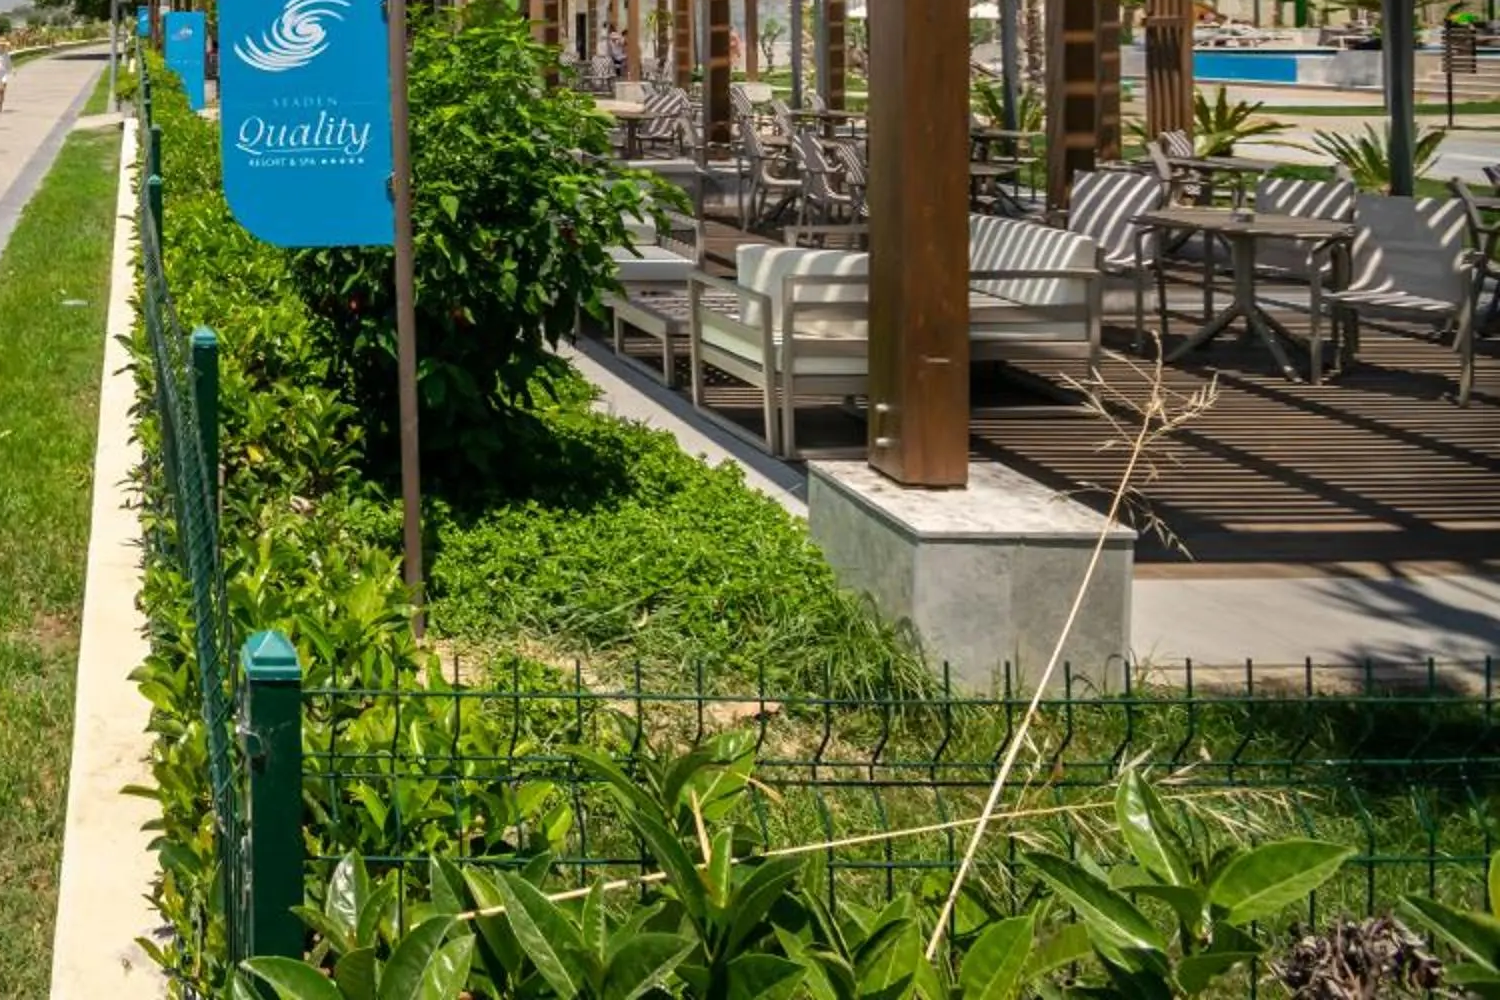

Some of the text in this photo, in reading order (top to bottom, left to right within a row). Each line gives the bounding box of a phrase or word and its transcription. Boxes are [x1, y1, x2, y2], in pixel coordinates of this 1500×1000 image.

[235, 110, 371, 155] Quality
[248, 157, 287, 167] RESORT
[299, 157, 317, 167] SPA
